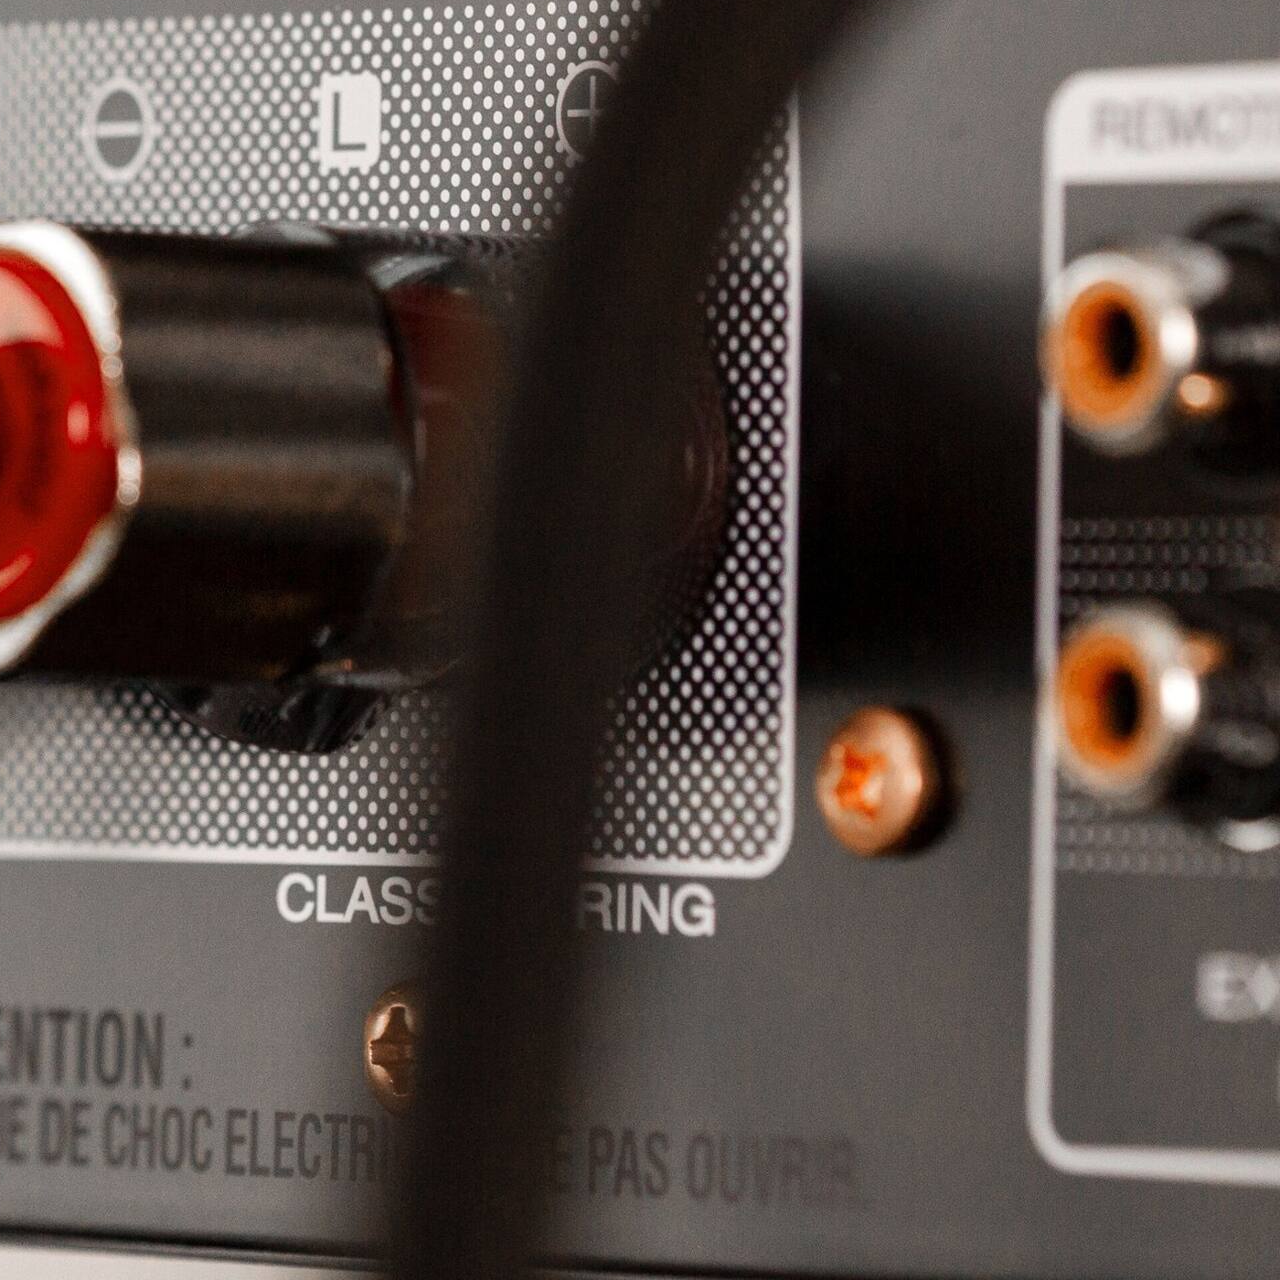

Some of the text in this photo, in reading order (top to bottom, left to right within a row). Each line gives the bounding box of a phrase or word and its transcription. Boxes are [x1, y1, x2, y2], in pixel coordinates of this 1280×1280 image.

[576, 881, 717, 937] RING
[41, 1097, 93, 1168] DE
[100, 1100, 213, 1173] CHOC
[224, 1106, 392, 1183] ELECTRI
[587, 1128, 671, 1199] PAS
